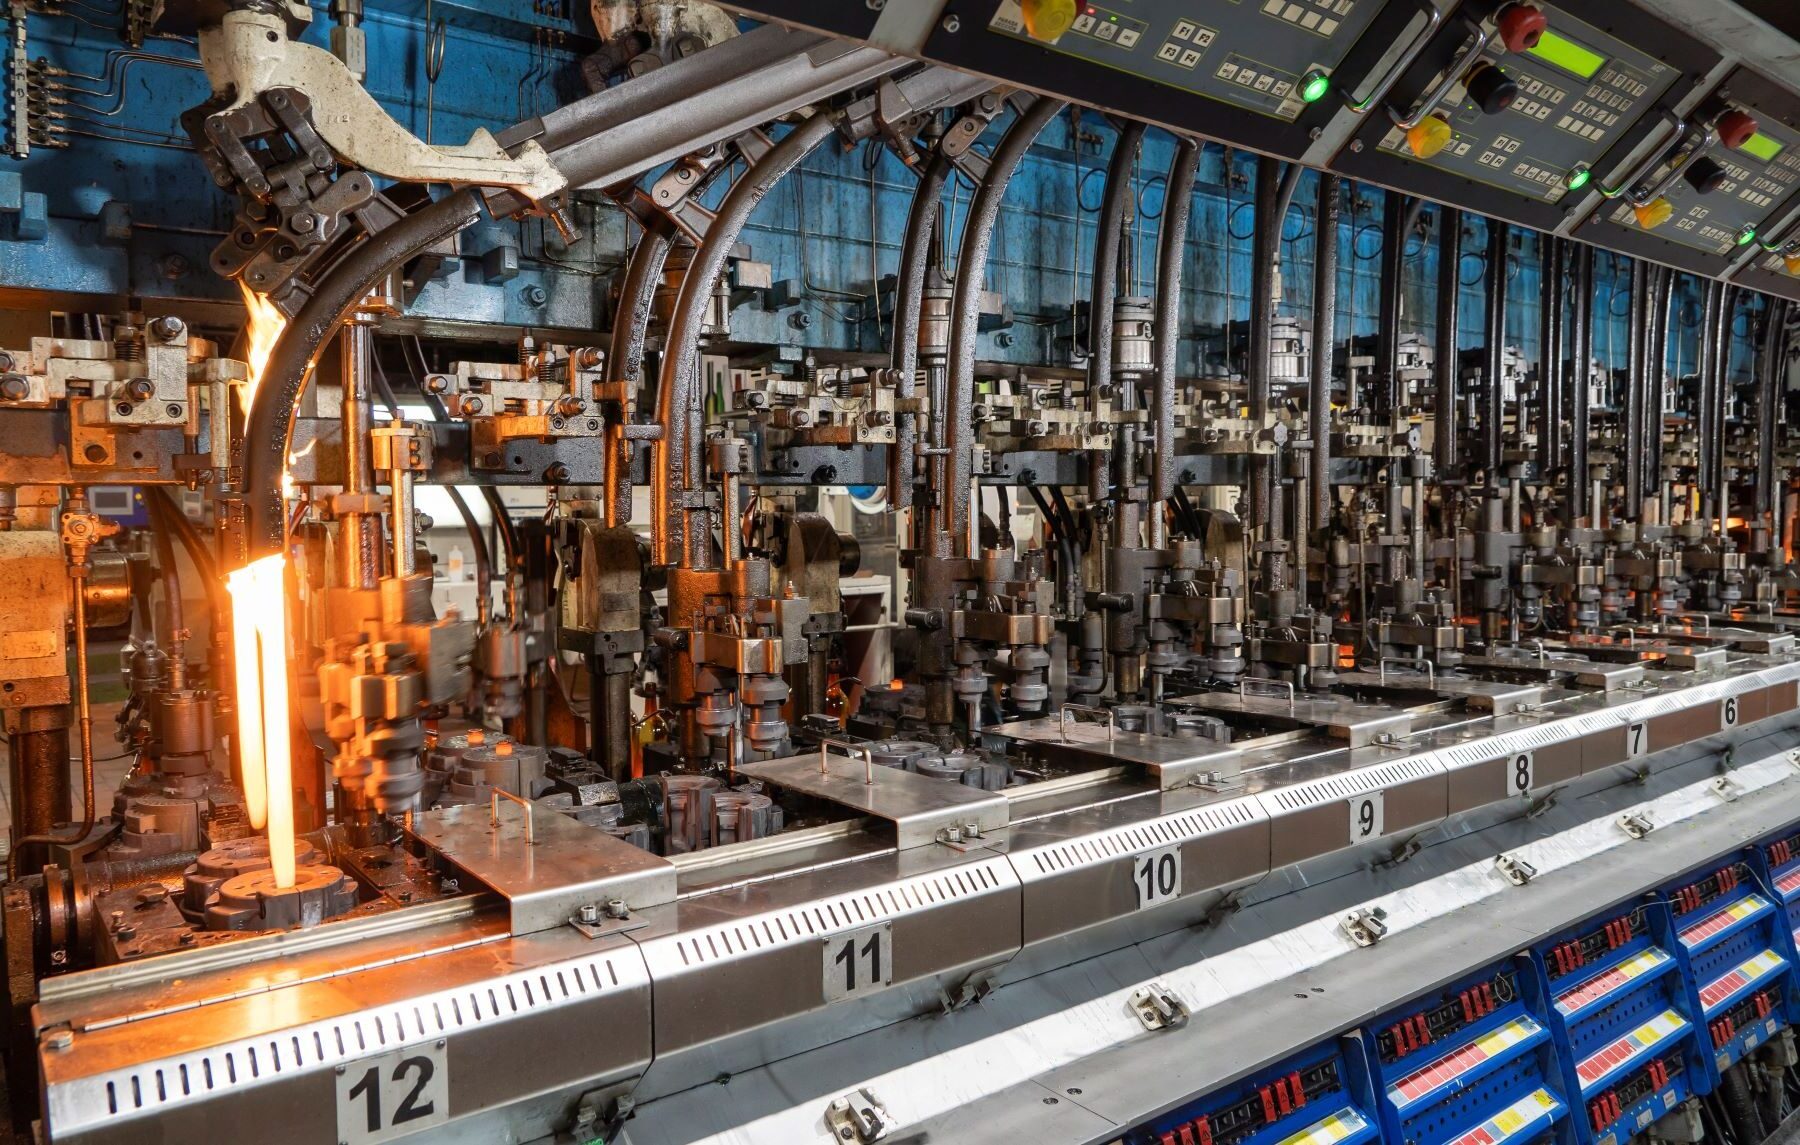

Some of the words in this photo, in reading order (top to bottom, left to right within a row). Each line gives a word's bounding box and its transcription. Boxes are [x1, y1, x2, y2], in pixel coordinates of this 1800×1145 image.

[1178, 26, 1190, 37] F1
[1198, 33, 1210, 43] F2
[1164, 47, 1177, 57] F3
[1184, 53, 1197, 64] F4
[1725, 697, 1736, 725] 6
[1631, 723, 1643, 755] 7
[1515, 754, 1530, 791] 8
[1360, 799, 1374, 836] 9
[1140, 853, 1176, 901] 10
[835, 932, 881, 992] 11
[349, 1055, 435, 1133] 12
